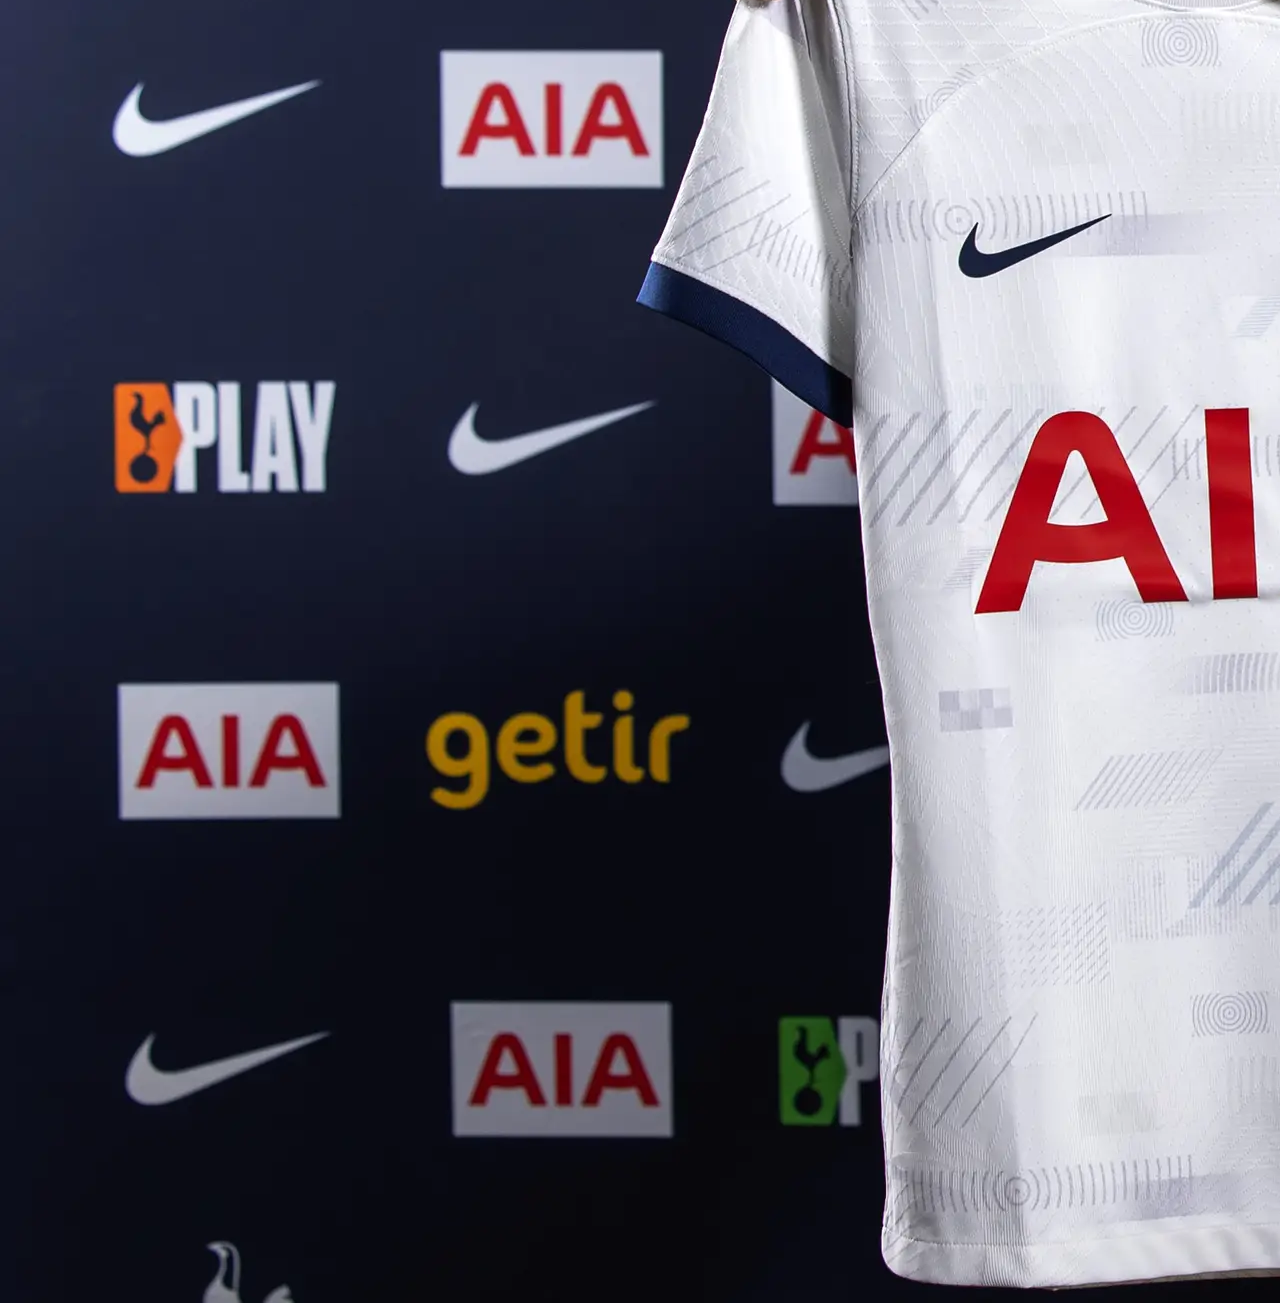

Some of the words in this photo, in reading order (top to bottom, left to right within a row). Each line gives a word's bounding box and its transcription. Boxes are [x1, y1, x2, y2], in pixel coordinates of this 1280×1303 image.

[458, 82, 649, 157] AIA
[174, 379, 337, 494] PLAY
[136, 713, 325, 789] AIA
[427, 690, 689, 809] getir
[470, 1032, 657, 1107] AIA
